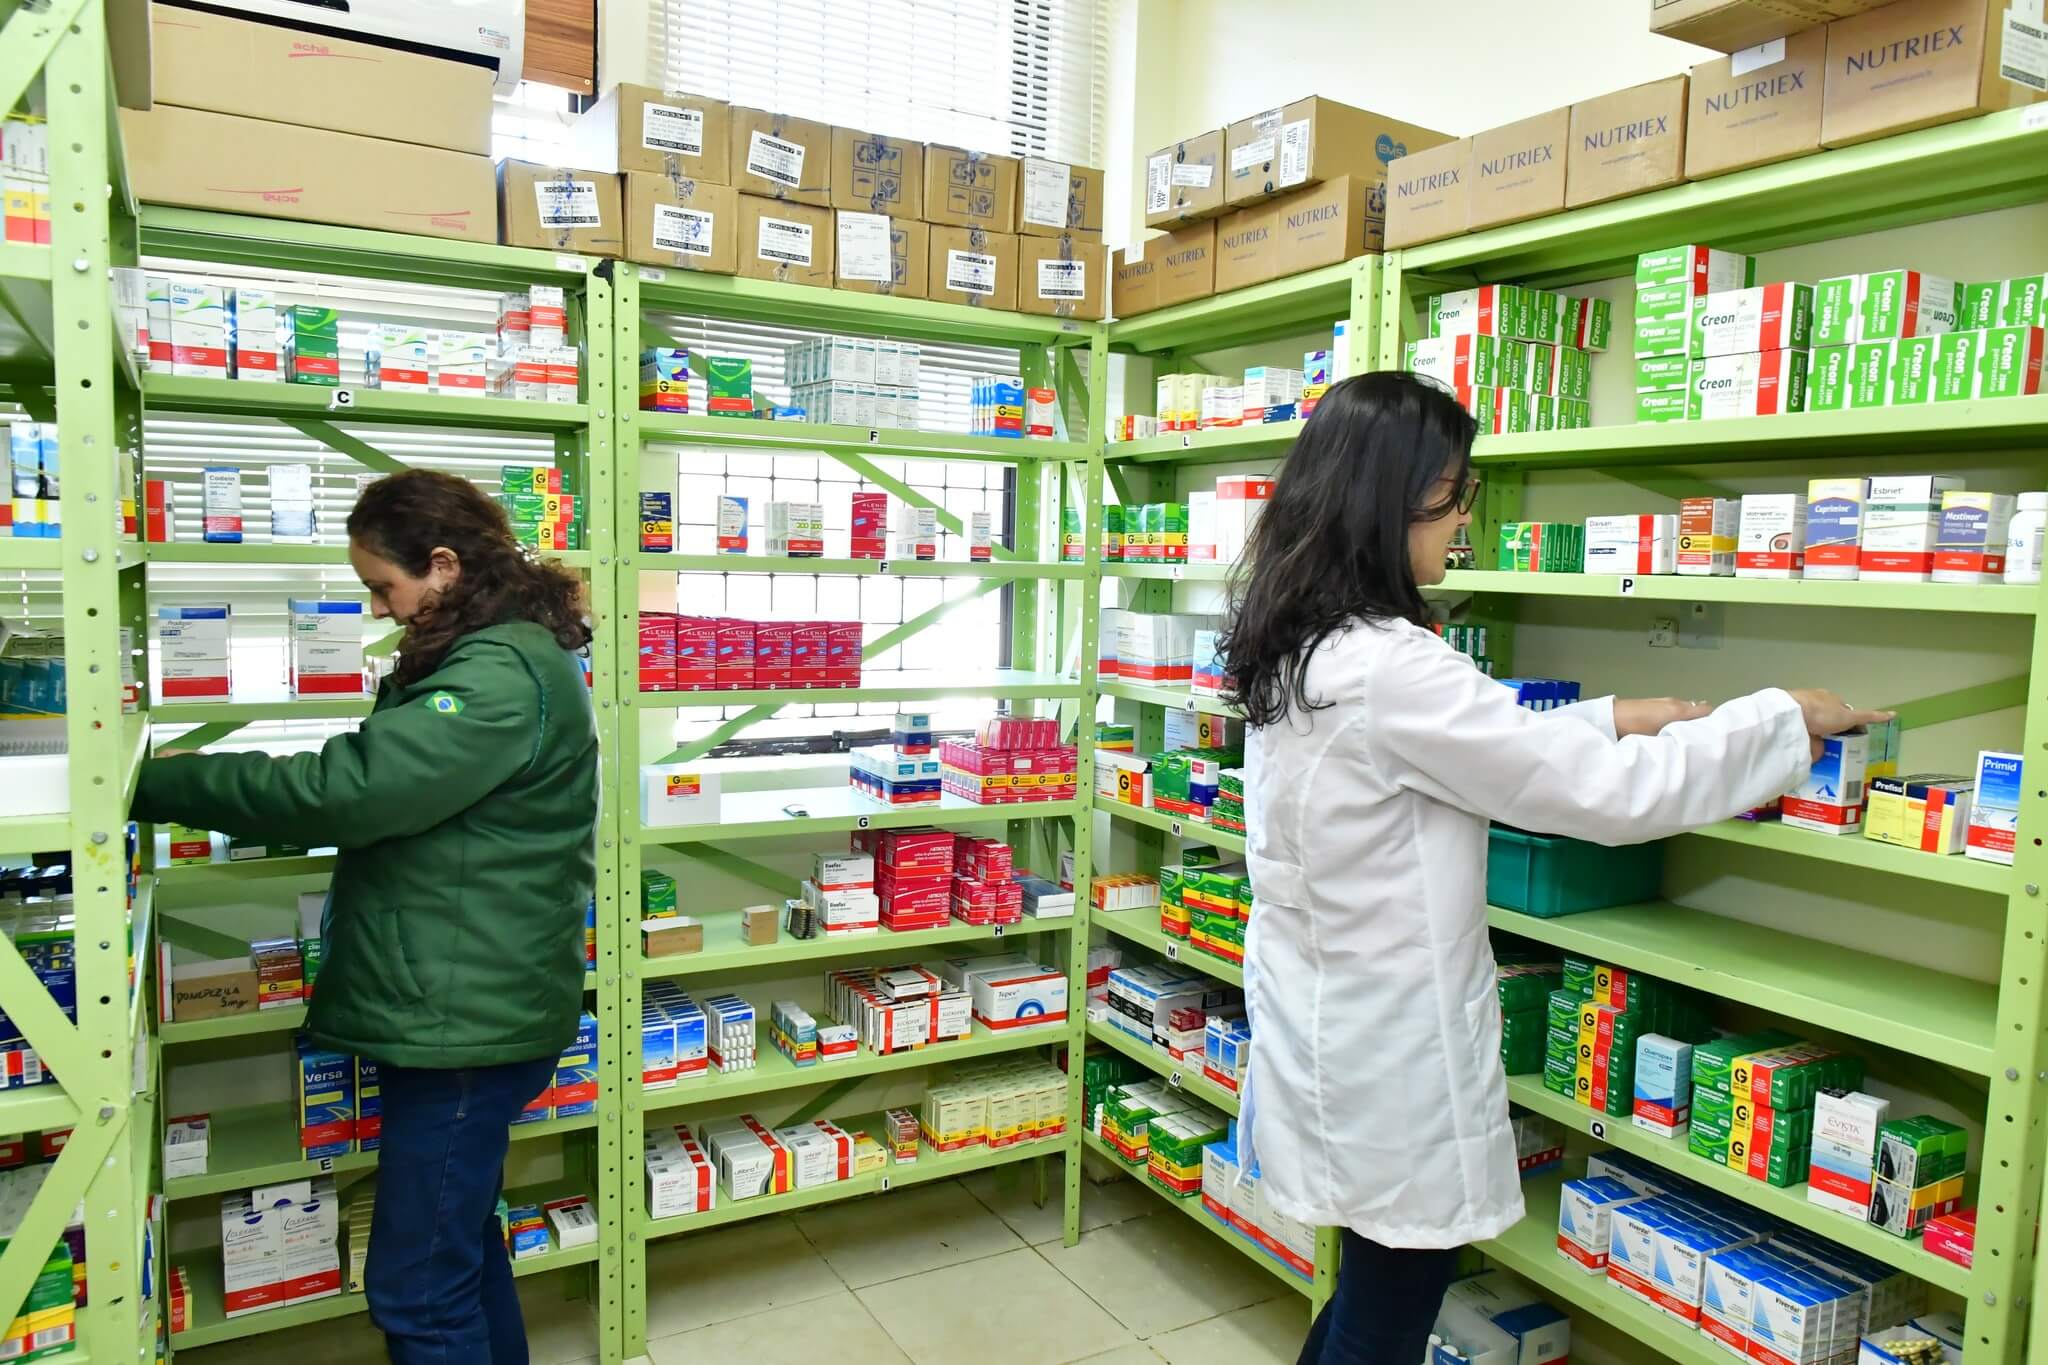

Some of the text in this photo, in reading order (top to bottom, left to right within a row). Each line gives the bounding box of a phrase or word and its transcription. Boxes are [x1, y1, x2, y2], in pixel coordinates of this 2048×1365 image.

[1846, 24, 1964, 75] NUTRIEX
[1705, 71, 1805, 115] NUTRIEX
[1584, 116, 1668, 152] NUTRIEX
[1480, 144, 1553, 178] NUTRIEX
[1397, 168, 1461, 198] NUTRIEX
[1286, 204, 1340, 229] NUTRIEX
[1223, 227, 1269, 249] NUTRIEX
[1166, 248, 1206, 268] NUTRIEX
[1641, 257, 1668, 268] Creon
[1640, 292, 1666, 302] Creon
[1882, 278, 1895, 312] Creon
[2023, 283, 2038, 317] Creon
[1979, 288, 1993, 322] Creon
[1437, 309, 1460, 321] Creon
[1500, 302, 1509, 334] Creon
[1519, 305, 1528, 336] Creon
[1701, 313, 1735, 327] Creon
[1933, 310, 1955, 326] Creon
[1538, 308, 1548, 338] Creon
[1591, 315, 1601, 345] Creon
[1794, 309, 1803, 340] Creon
[1819, 308, 1832, 339] Creon
[1640, 327, 1666, 337] Creon
[1955, 338, 1969, 374] Creon
[2001, 333, 2016, 369] Creon
[1413, 356, 1436, 367] Creon
[1477, 351, 1486, 383] Creon
[1642, 362, 1668, 372] Creon
[1869, 349, 1882, 383] Creon
[1911, 343, 1926, 378] Creon
[1510, 358, 1519, 389] Creon
[1829, 352, 1841, 385] Creon
[1534, 361, 1544, 391] Creon
[1561, 364, 1569, 394] Creon
[1574, 367, 1583, 396] Creon
[659, 381, 670, 392] G
[1699, 378, 1732, 390] Creon
[1791, 375, 1800, 407] Creon
[337, 391, 350, 404] C
[1303, 388, 1310, 398] G
[1642, 397, 1669, 407] Creon
[998, 405, 1007, 416] G
[869, 430, 878, 442] F
[1183, 437, 1188, 446] L
[536, 474, 545, 484] G
[1873, 487, 1901, 495] Esbriet
[548, 500, 557, 511] G
[541, 528, 551, 539] G
[645, 523, 654, 533] G
[880, 563, 888, 572] F
[1622, 579, 1633, 592] P
[1200, 724, 1209, 738] G
[1984, 759, 2018, 772] Primid
[1119, 774, 1129, 790] G
[859, 818, 868, 828] G
[1173, 824, 1180, 833] M
[994, 927, 1003, 935] H
[1168, 945, 1175, 957] M
[1598, 974, 1608, 986] G
[1584, 1013, 1594, 1025] G
[1581, 1045, 1591, 1058] G
[305, 1069, 343, 1083] Versa
[1170, 1073, 1181, 1085] M
[1735, 1068, 1748, 1083] G
[1578, 1077, 1588, 1090] G
[1736, 1105, 1747, 1120] G
[1591, 1122, 1604, 1138] Q
[1731, 1141, 1744, 1156] G
[1149, 1151, 1155, 1161] G
[321, 1158, 331, 1170] E
[1165, 1161, 1171, 1171] G
[1628, 1221, 1650, 1235] Viverdal
[1673, 1243, 1697, 1259] Viverdal
[1724, 1271, 1749, 1287] Viverdal
[1775, 1297, 1801, 1313] Viverdal
